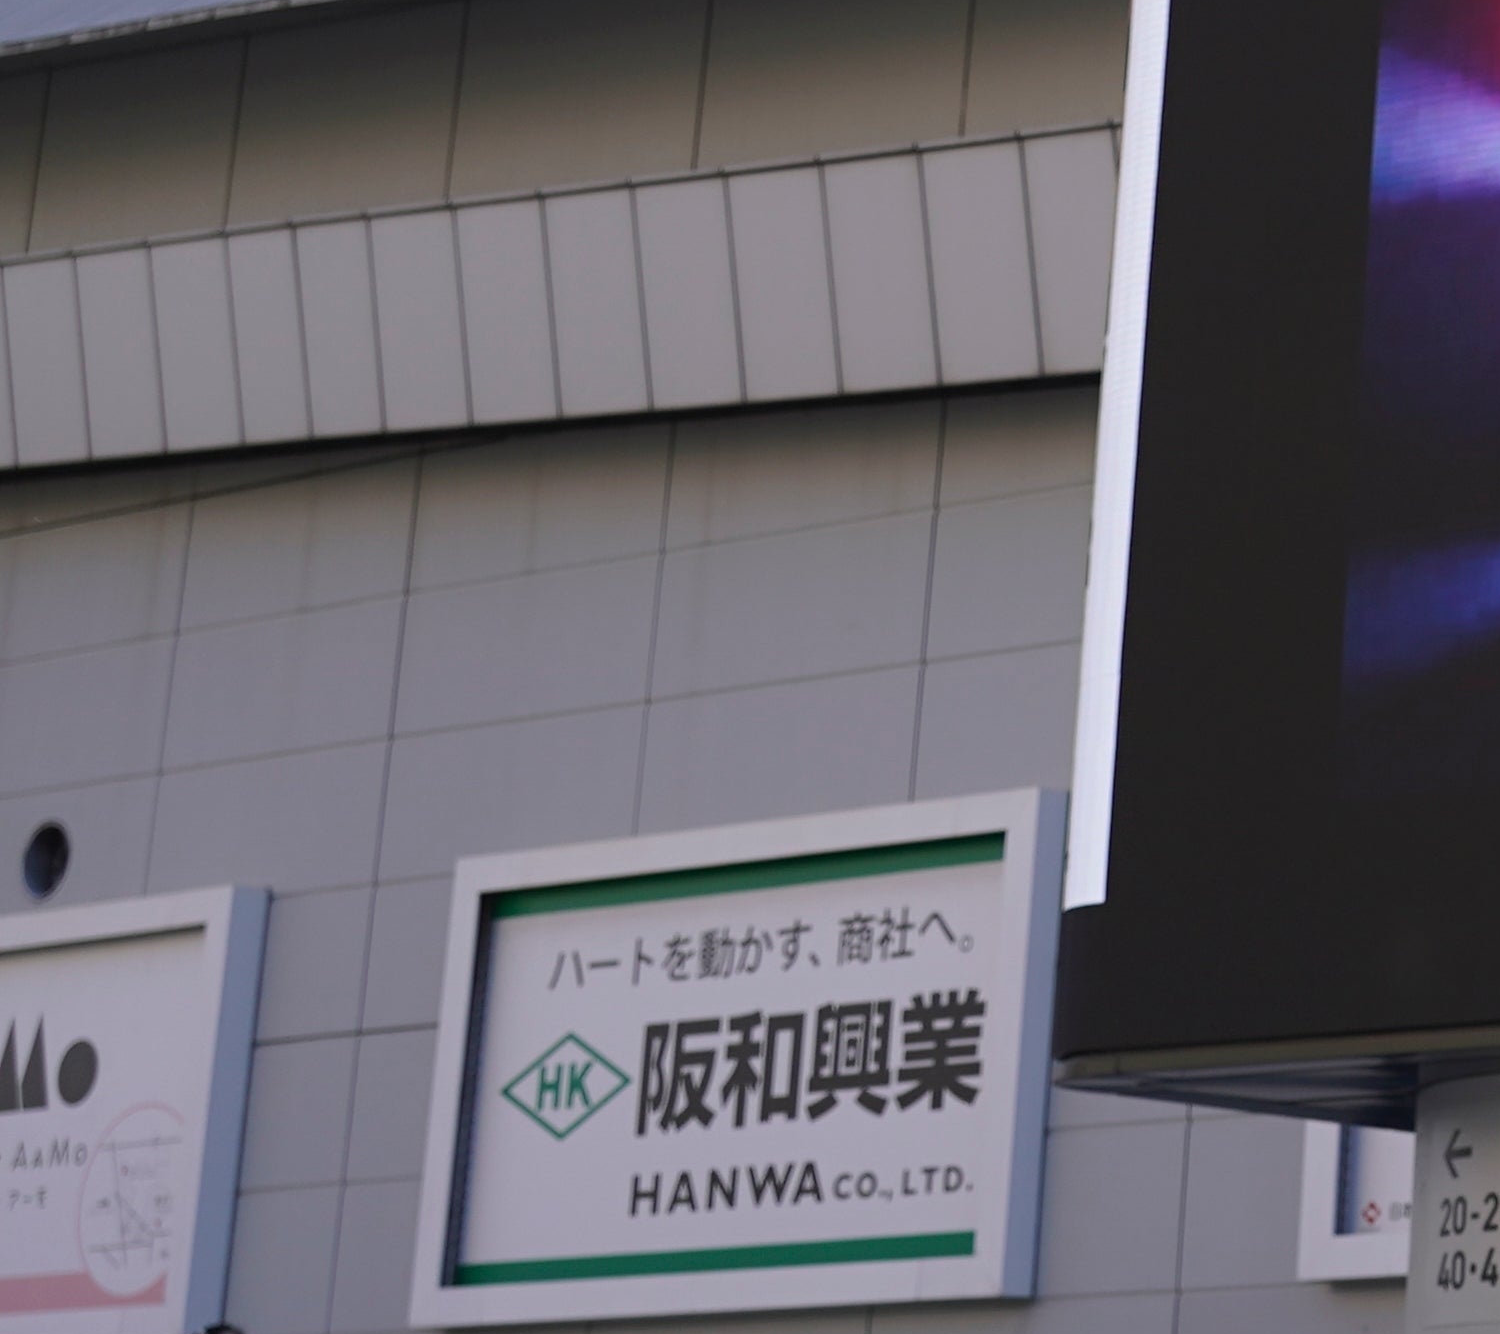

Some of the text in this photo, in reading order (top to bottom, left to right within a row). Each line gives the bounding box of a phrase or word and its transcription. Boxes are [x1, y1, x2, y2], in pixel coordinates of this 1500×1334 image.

[536, 1061, 594, 1111] HK
[635, 988, 987, 1137] 阪和興業
[629, 1161, 825, 1217] HANWA
